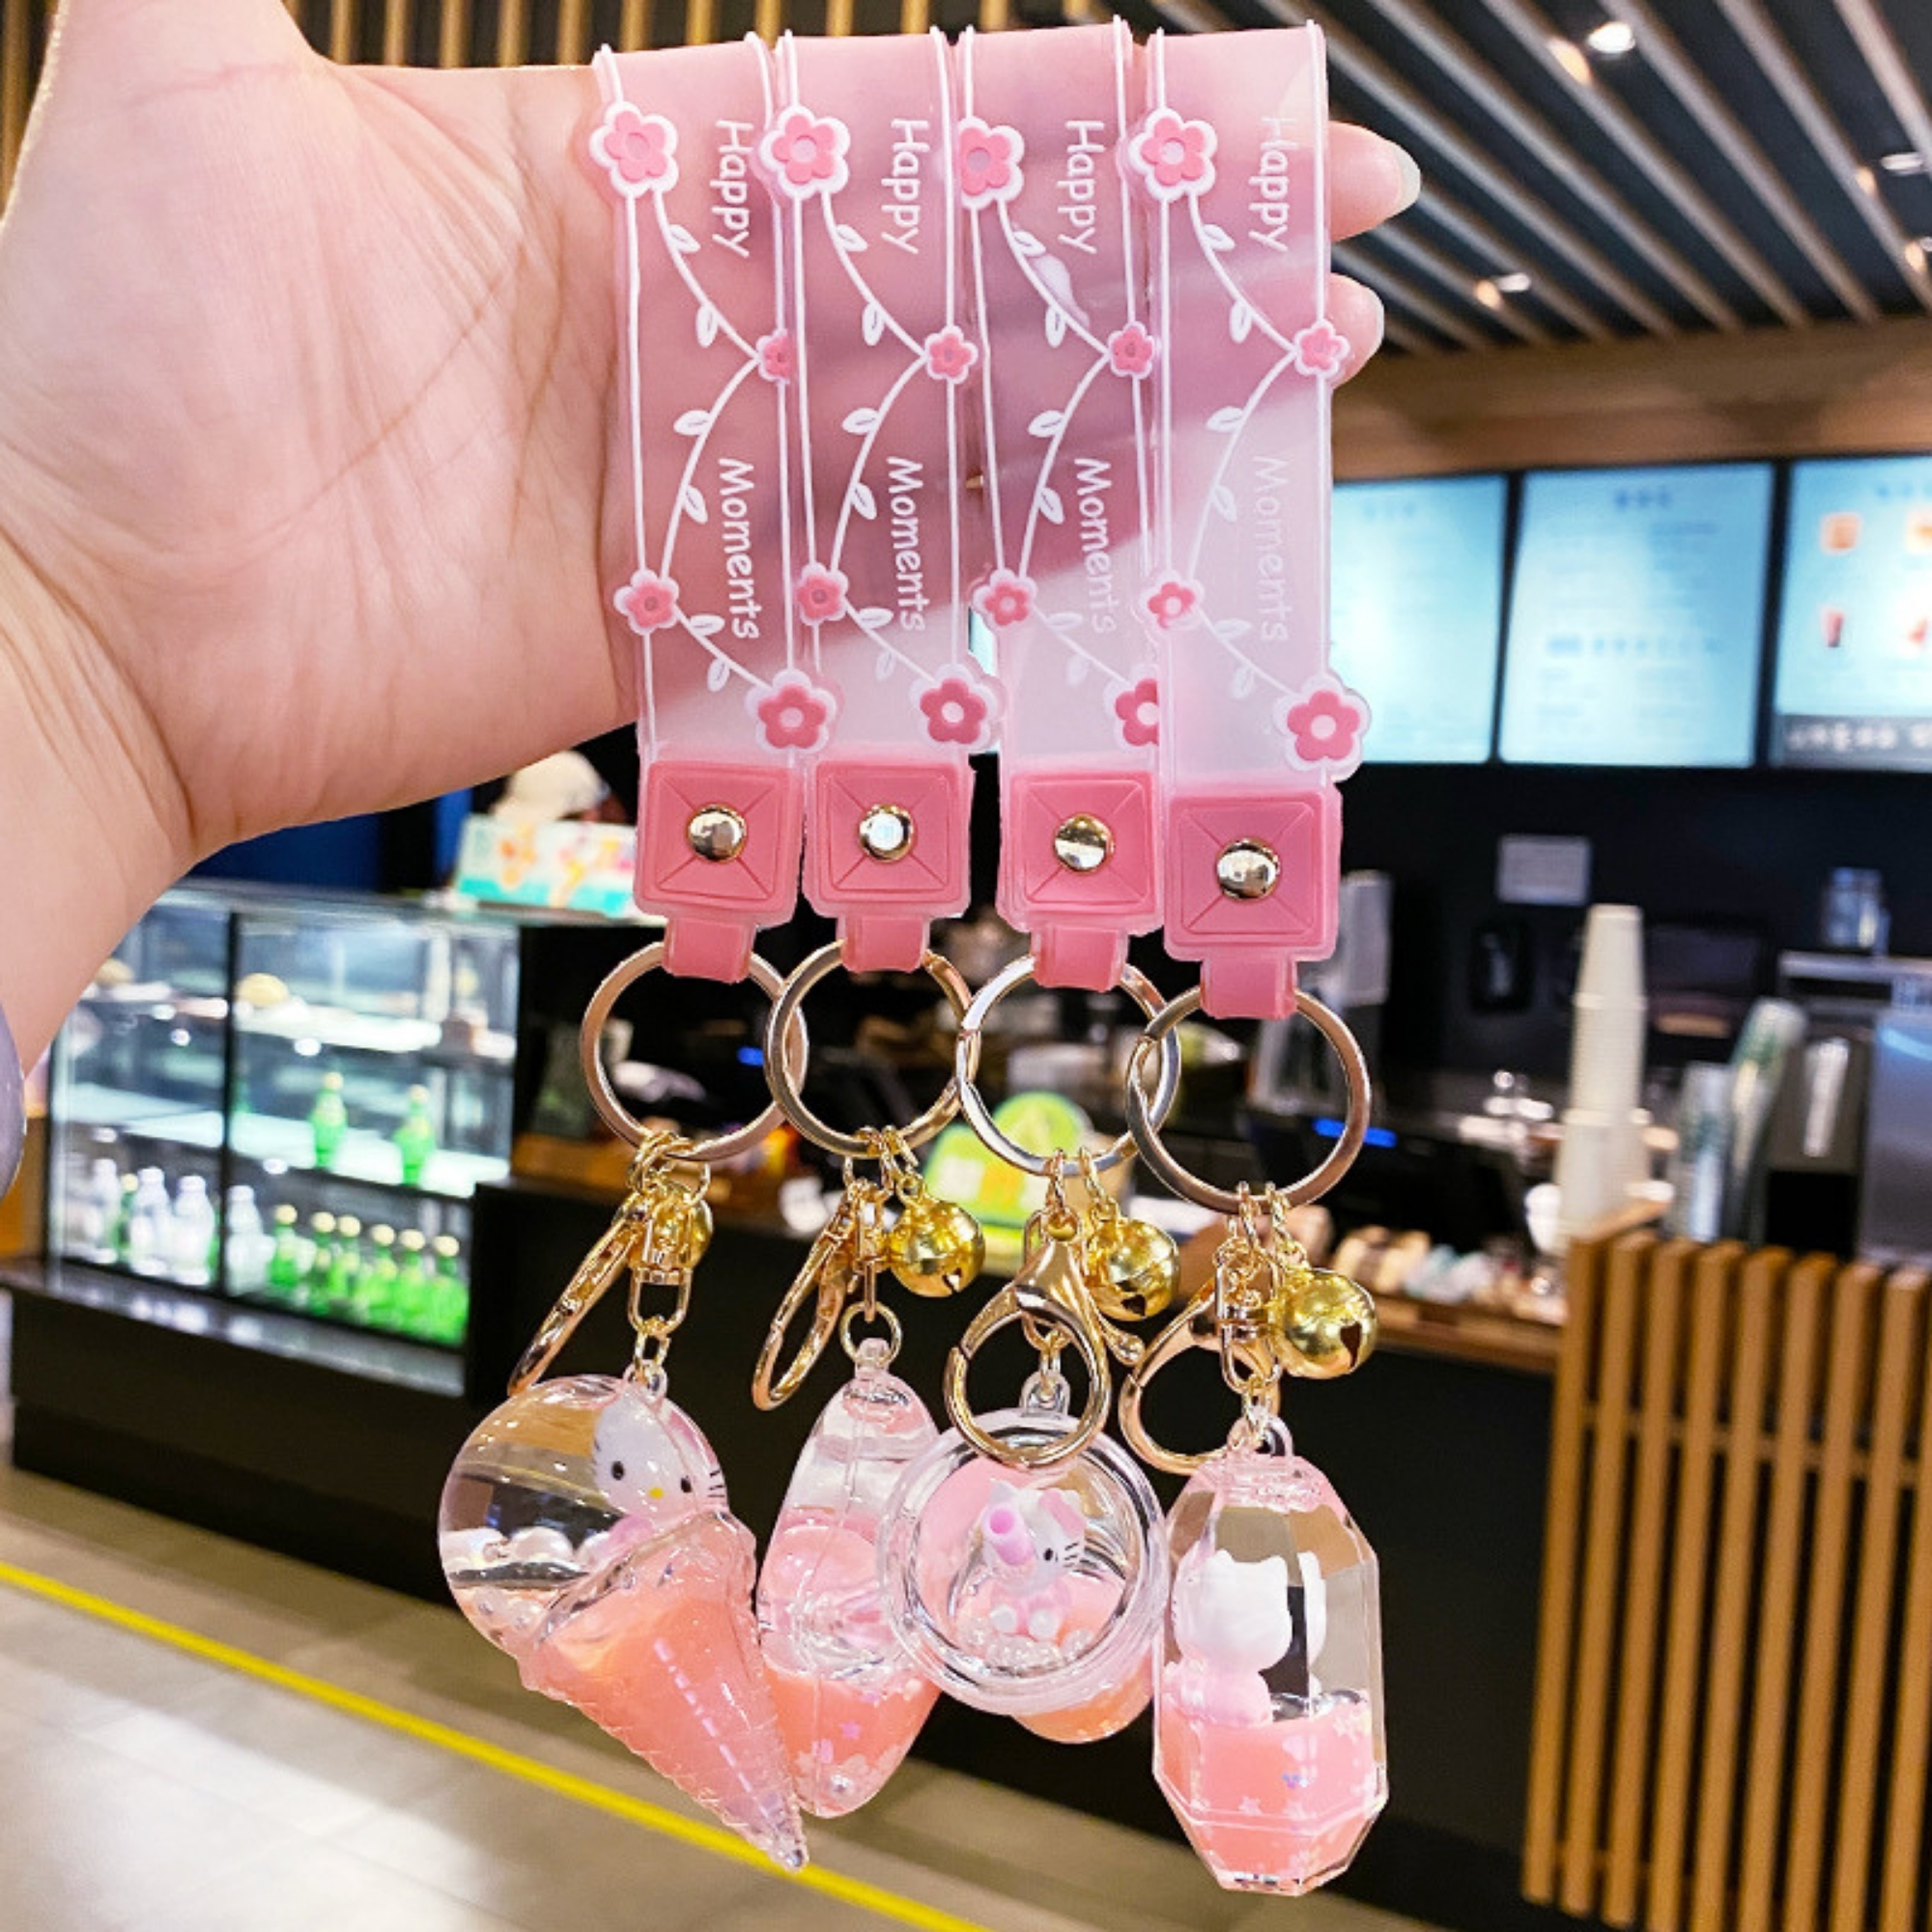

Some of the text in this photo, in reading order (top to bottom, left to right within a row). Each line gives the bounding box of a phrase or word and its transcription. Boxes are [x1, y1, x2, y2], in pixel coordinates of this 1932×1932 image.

[711, 120, 761, 639] Happy Moments
[881, 119, 929, 631] Happy Moments
[1058, 120, 1118, 634] Happy Moments
[1248, 117, 1296, 641] Happy Moments
